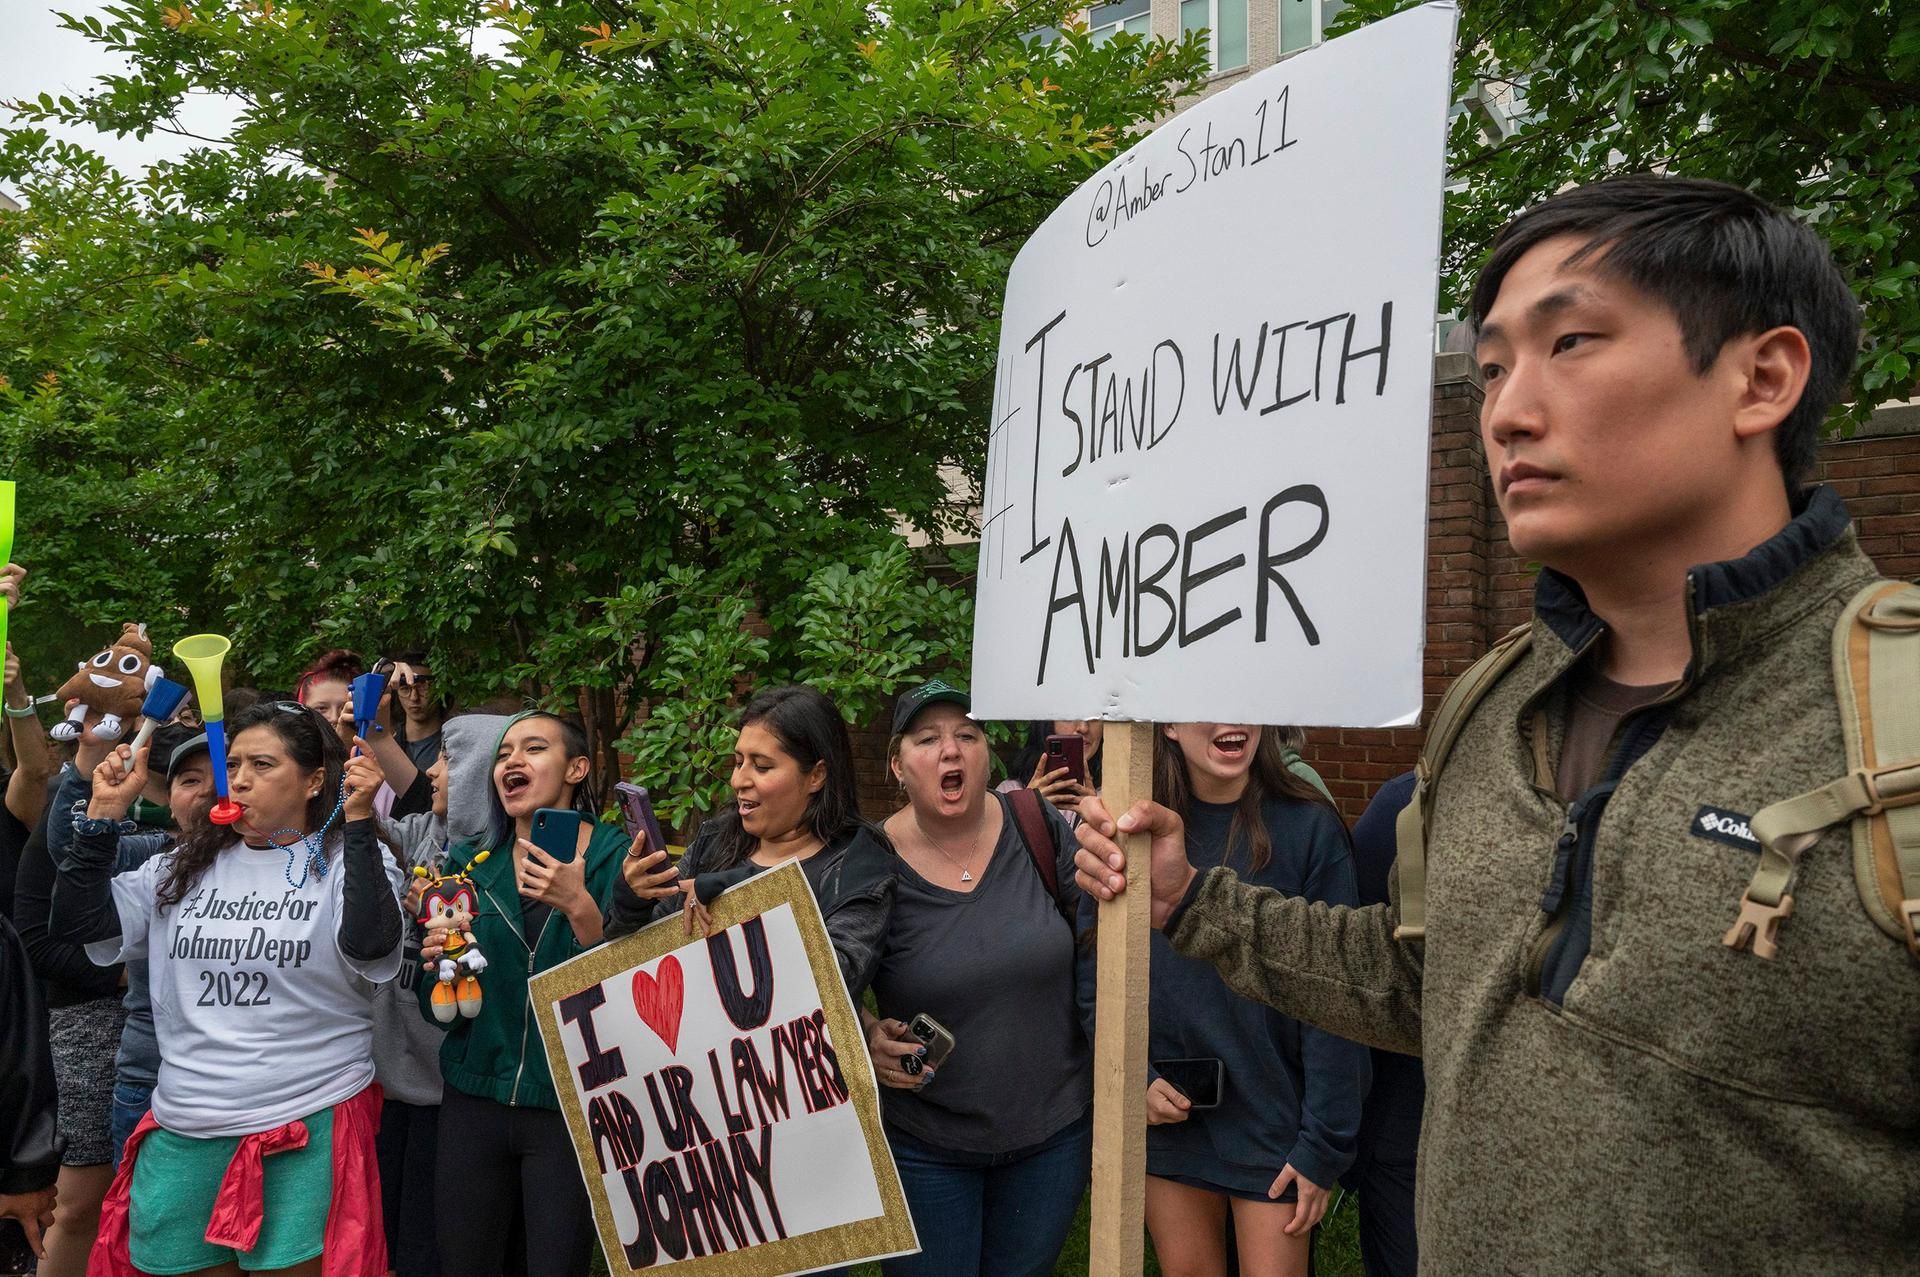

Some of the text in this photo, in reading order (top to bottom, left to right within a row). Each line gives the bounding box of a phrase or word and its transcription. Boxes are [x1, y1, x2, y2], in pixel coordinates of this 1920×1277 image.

[1062, 338, 1185, 478] STAND
[1212, 301, 1393, 416] WITH
[1037, 483, 1330, 687] AMBER
[1717, 817, 1760, 843] Colu
[169, 924, 312, 969] JohnnyDepp
[181, 887, 318, 922] #JusticeFor
[196, 970, 272, 1007] 2022
[558, 913, 774, 1093] I U
[587, 1008, 850, 1175] AND UR LAWYERS
[622, 1123, 789, 1271] JOHNNY
